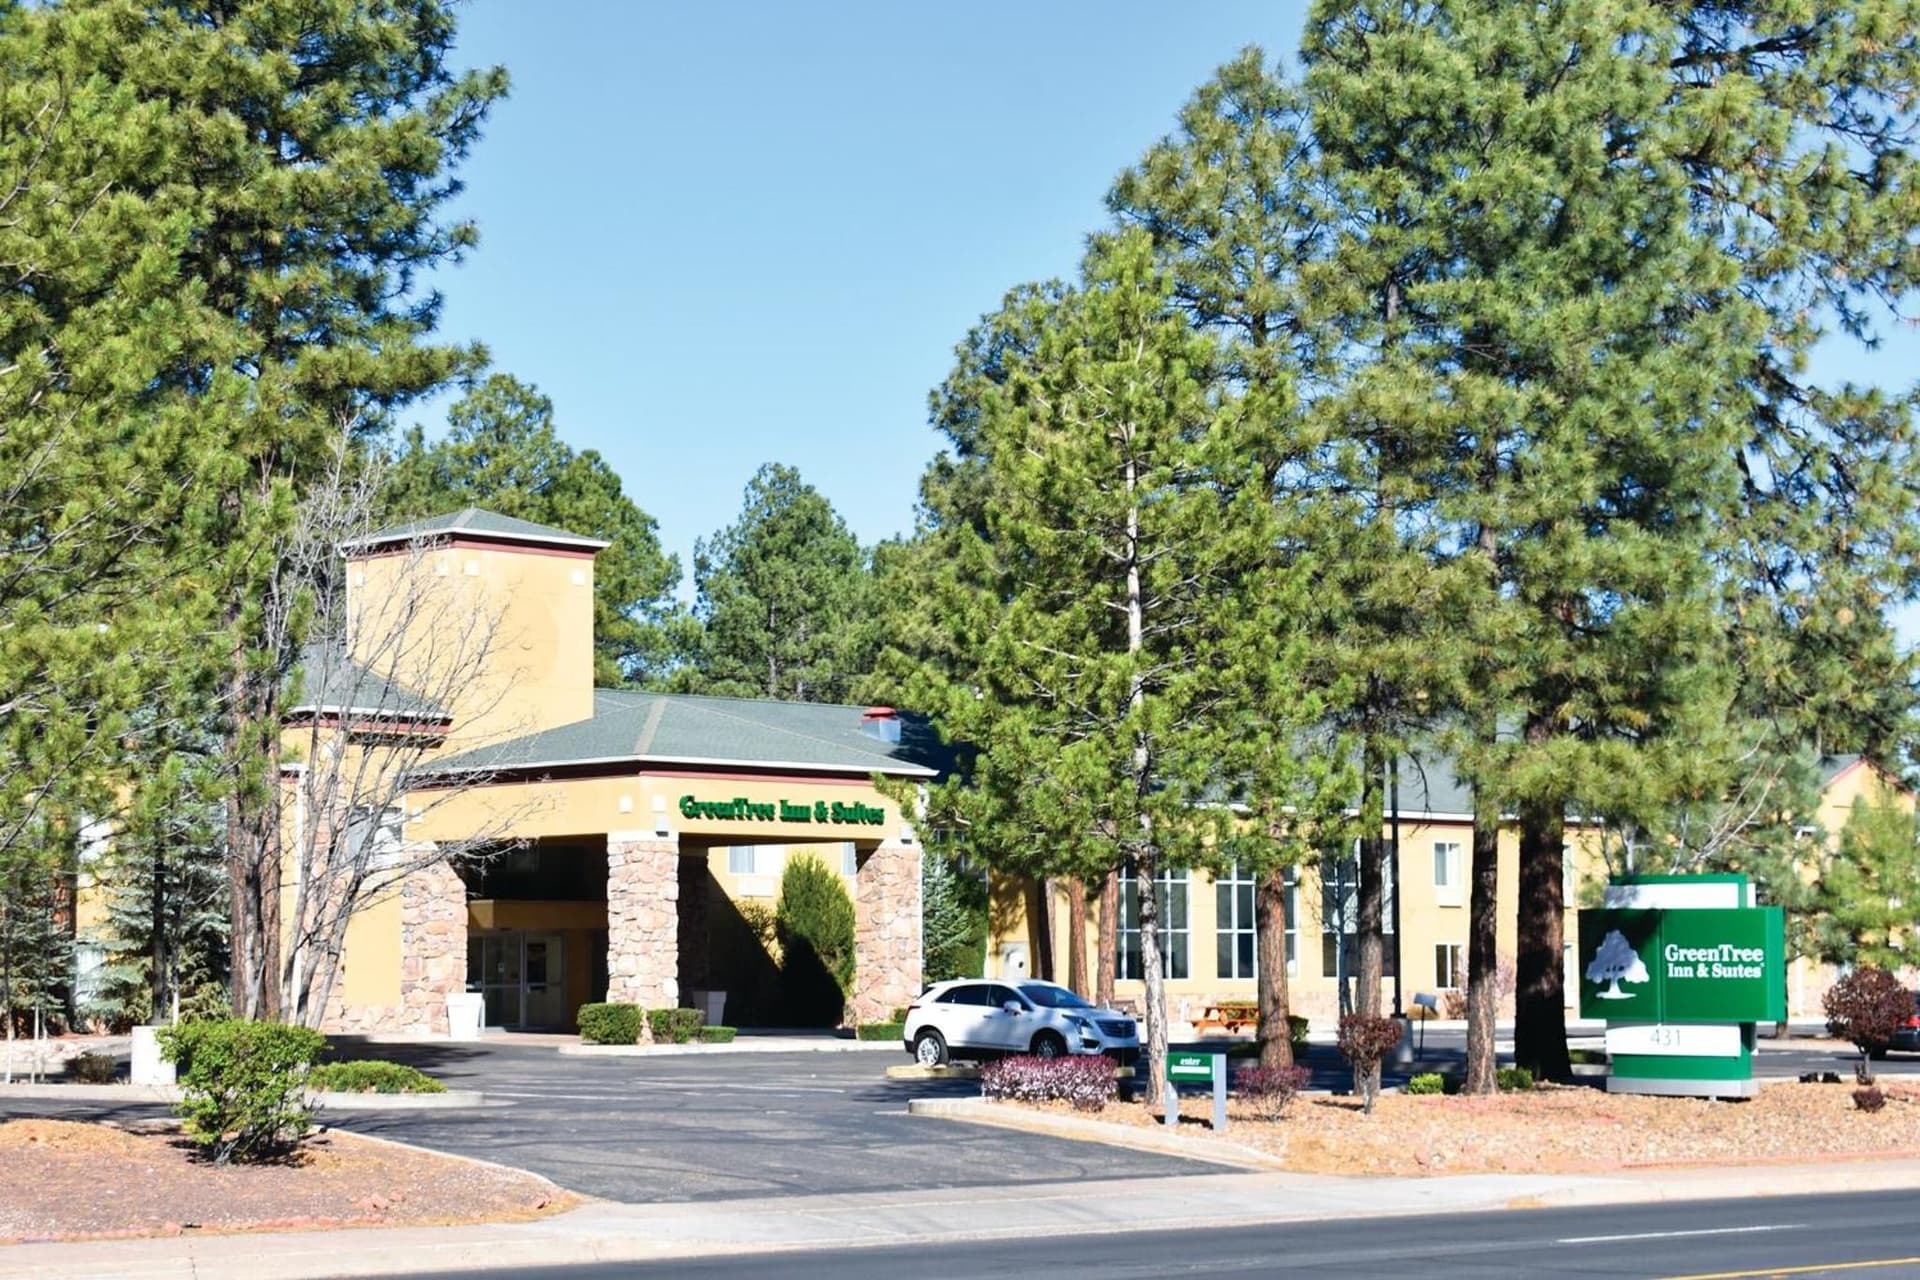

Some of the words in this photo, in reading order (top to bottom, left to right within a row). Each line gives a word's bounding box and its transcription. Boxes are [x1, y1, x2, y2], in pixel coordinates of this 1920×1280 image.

[679, 795, 775, 821] GreenTree
[779, 799, 811, 823] Inn
[814, 801, 829, 823] &
[831, 801, 885, 825] Suites
[1664, 944, 1764, 962] GreenTree
[1667, 963, 1694, 978] Inn
[1696, 963, 1708, 978] &
[1711, 963, 1762, 978] Suites
[1650, 1029, 1681, 1047] 431
[1180, 1057, 1201, 1066] enter
